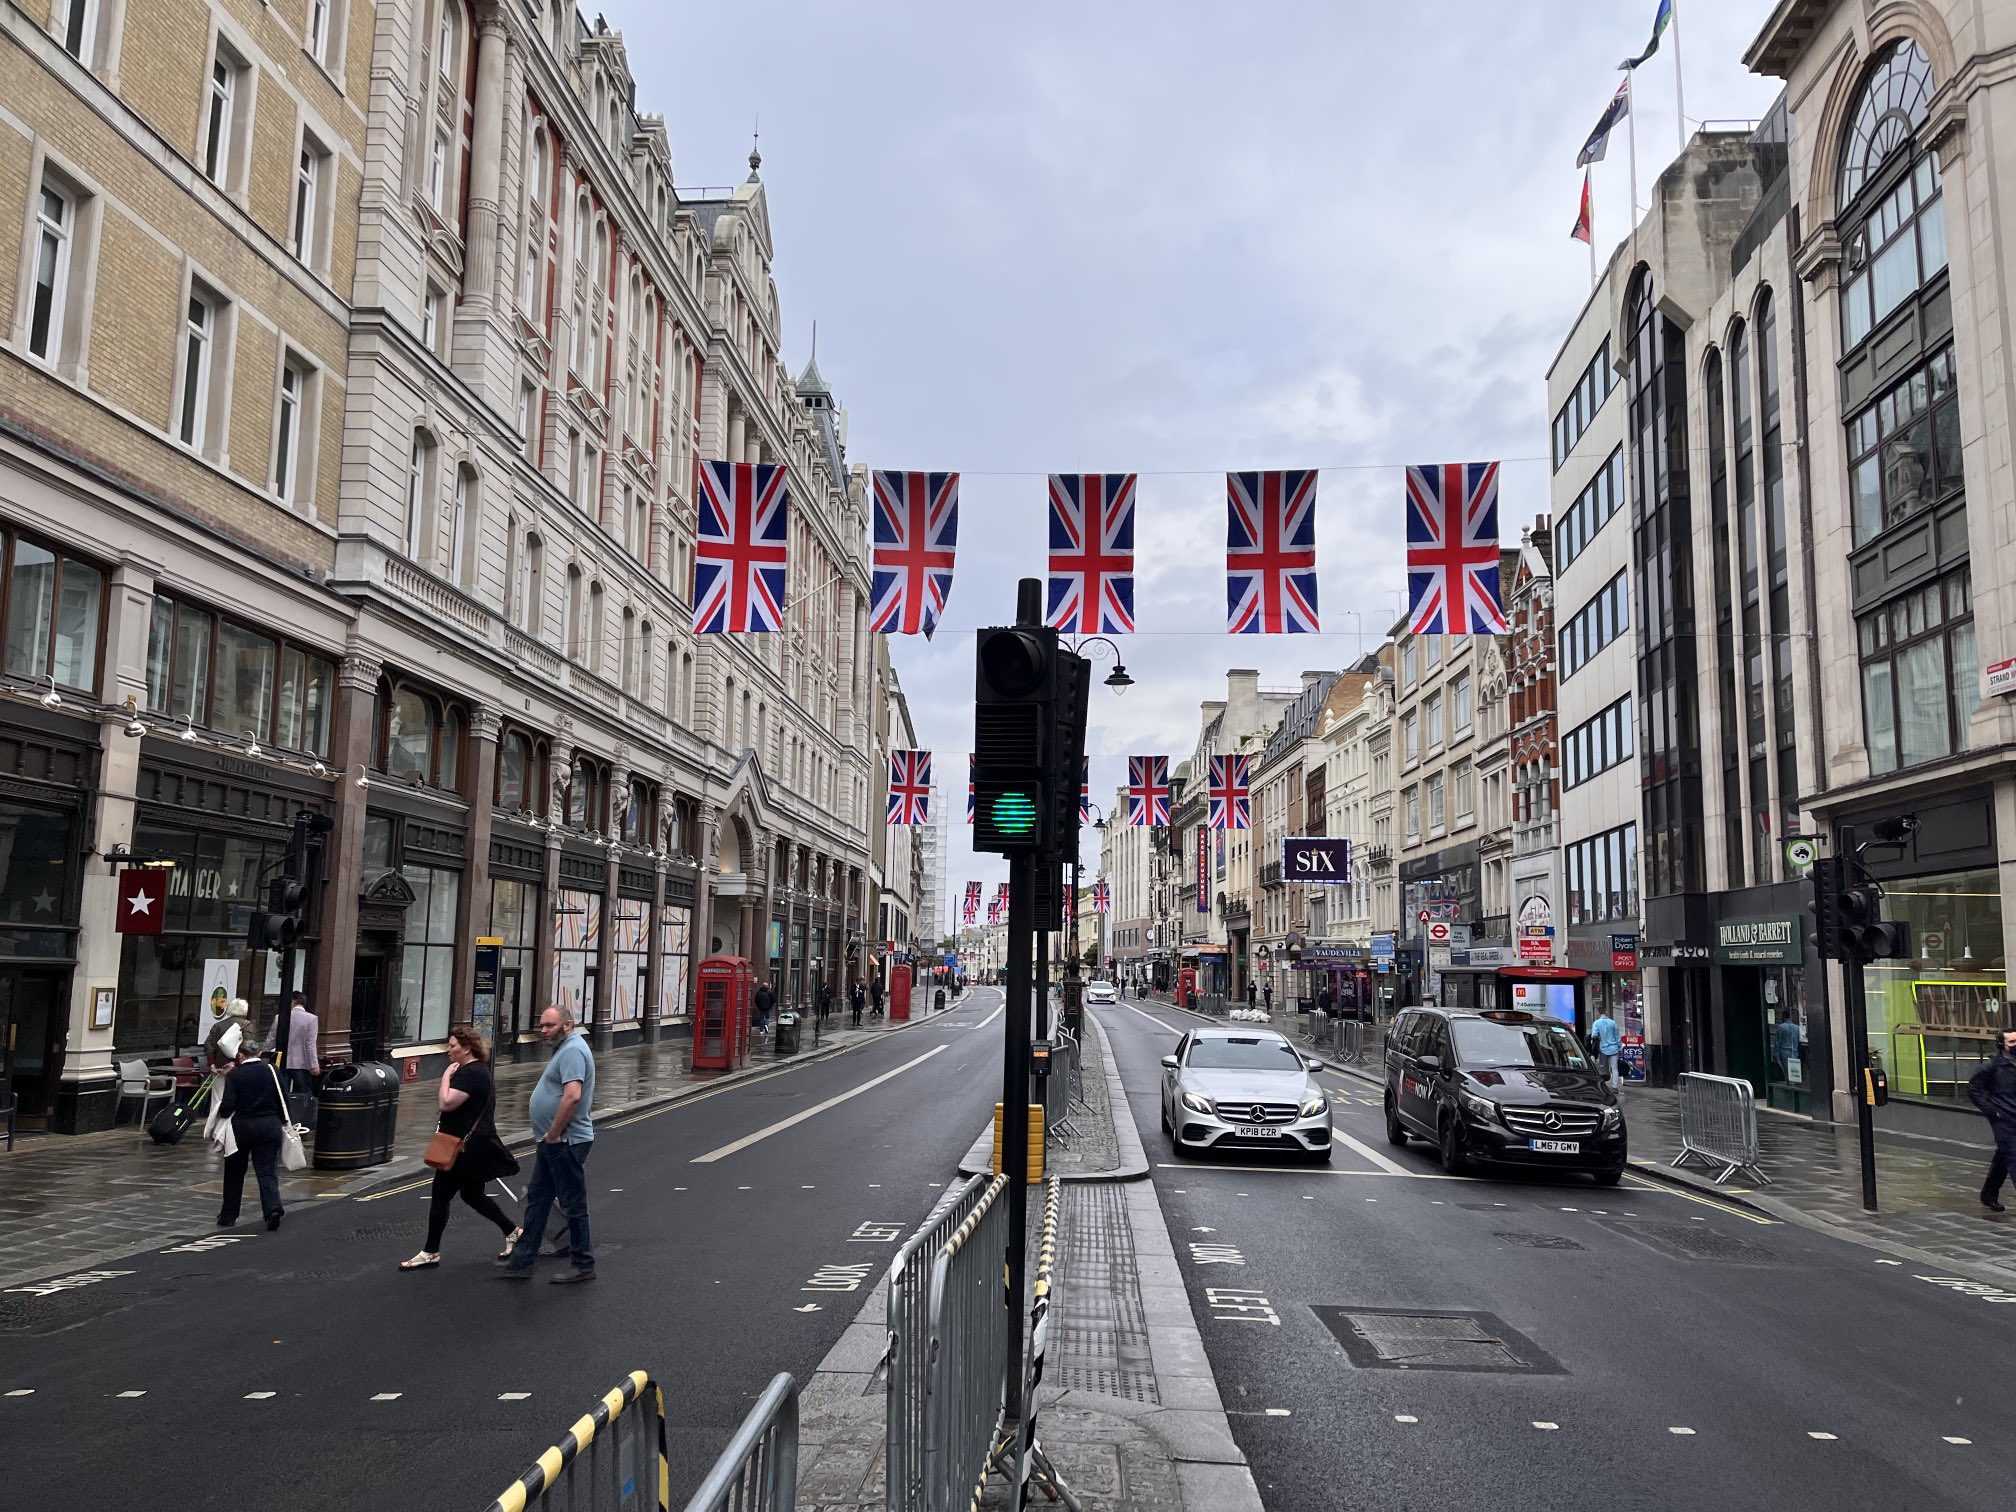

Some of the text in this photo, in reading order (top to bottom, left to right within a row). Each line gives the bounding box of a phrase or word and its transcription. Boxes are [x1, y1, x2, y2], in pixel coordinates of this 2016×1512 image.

[1990, 671, 2010, 686] STRAND
[1296, 848, 1336, 872] SIX
[169, 867, 221, 900] MANGER
[1421, 911, 1429, 920] A
[1720, 921, 1792, 946] HOLLAND & BARRETT
[1315, 949, 1363, 957] VAUDEVILLE
[1614, 942, 1634, 950] Dyas
[1414, 1082, 1428, 1100] NOW
[1240, 1127, 1277, 1137] KP18 CZR
[1535, 1140, 1559, 1151] LM67
[800, 1221, 906, 1291] LOOK LEFT
[1188, 1243, 1245, 1265] LOOK
[3, 1234, 258, 1297] LOOK RIGHT
[1206, 1288, 1281, 1325] LEFT
